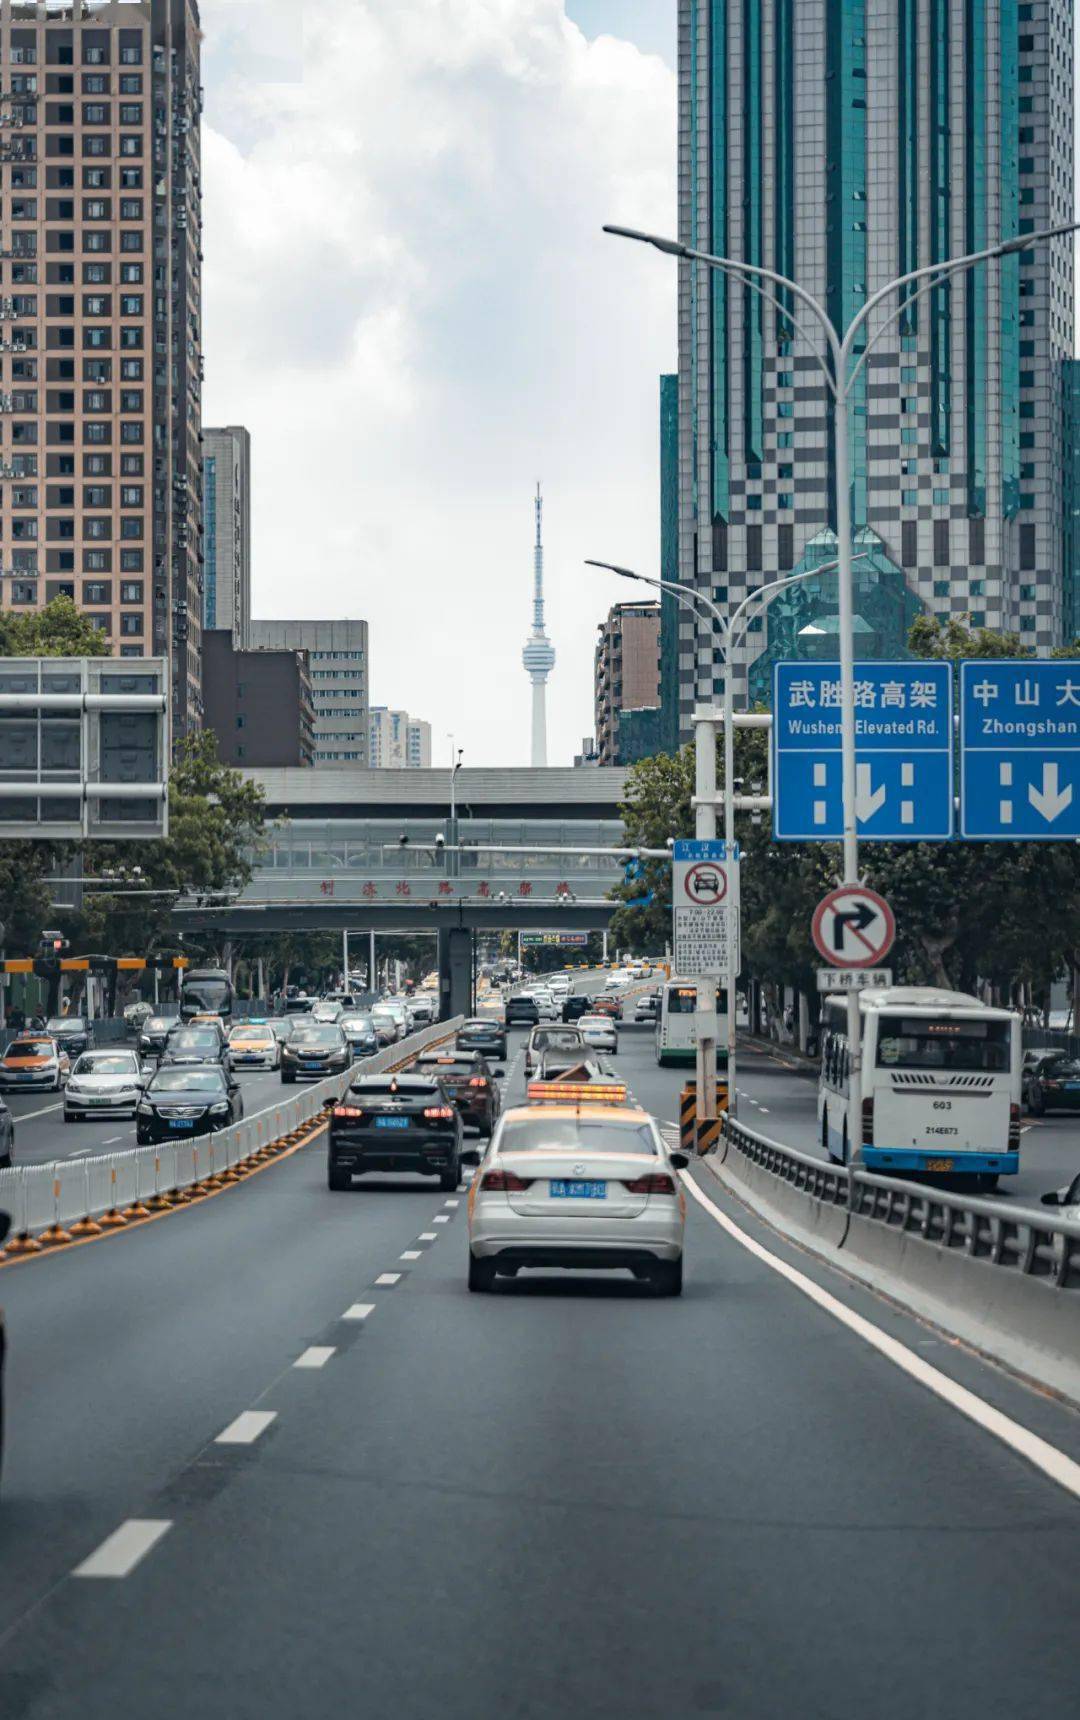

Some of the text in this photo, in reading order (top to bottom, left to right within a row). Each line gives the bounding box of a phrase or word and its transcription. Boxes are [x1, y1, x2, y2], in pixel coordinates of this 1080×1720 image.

[788, 680, 937, 708] 武胜路高架
[788, 719, 940, 734] Wushen Elevated Rd.
[982, 719, 1077, 736] Zhongshan
[823, 972, 887, 988] 下桥车辆
[933, 1101, 952, 1110] 603
